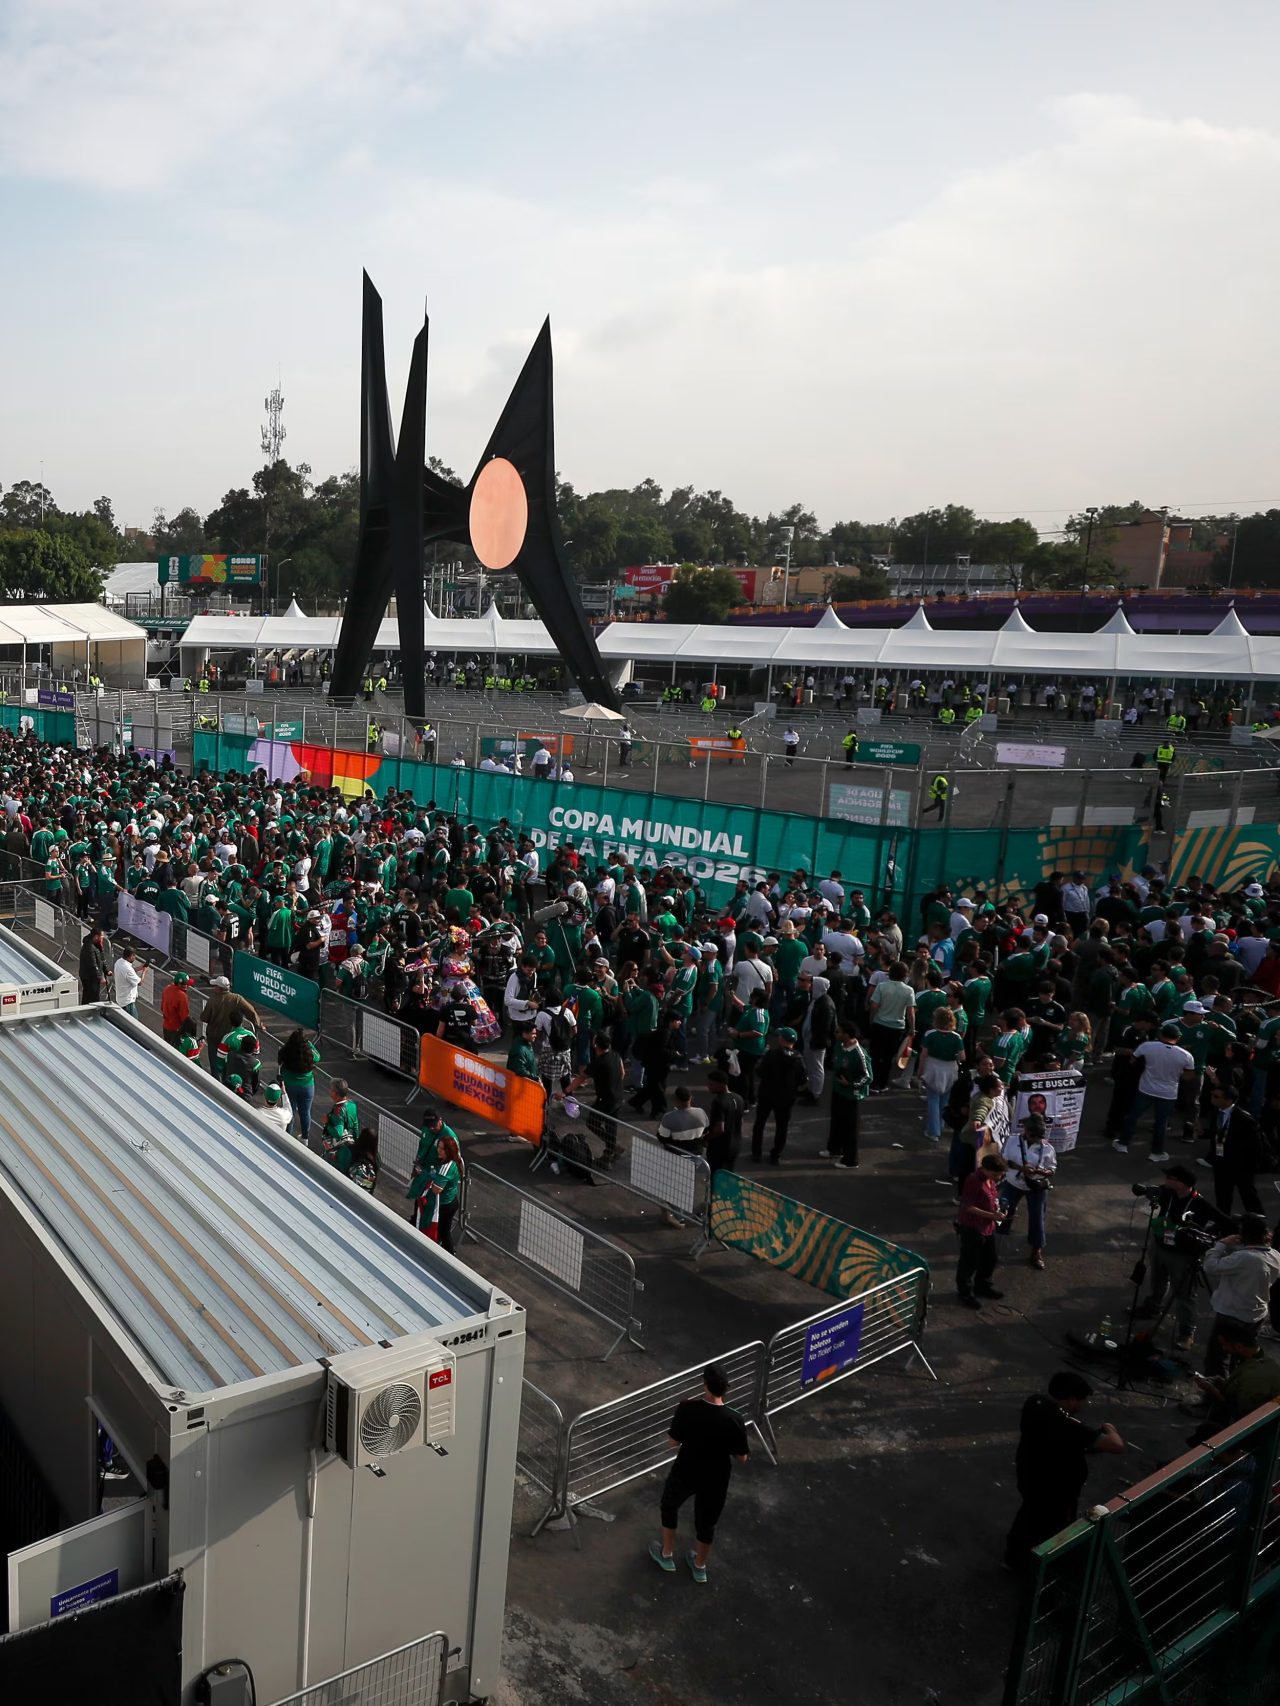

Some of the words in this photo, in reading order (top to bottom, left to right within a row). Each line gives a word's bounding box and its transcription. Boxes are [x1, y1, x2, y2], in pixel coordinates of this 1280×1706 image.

[548, 806, 616, 836] COPA
[620, 817, 749, 858] MUNDIAL
[530, 827, 562, 851] DE
[663, 851, 767, 886] 2026
[231, 921, 240, 939] 16
[265, 967, 283, 981] FIFA
[253, 971, 280, 990] WORLD
[280, 984, 297, 998] CUP
[260, 985, 288, 1005] 2026
[453, 1070, 491, 1094] CIUDAD
[492, 1087, 506, 1100] DE
[1031, 1081, 1044, 1090] SE
[1045, 1079, 1076, 1088] BUSCA
[453, 1080, 506, 1113] MÉXICO
[811, 1333, 820, 1341] No
[820, 1329, 828, 1338] se
[828, 1320, 849, 1335] venden
[808, 1353, 817, 1362] No
[817, 1345, 833, 1358] Ticket
[809, 1337, 832, 1352] boletos
[432, 1374, 449, 1384] TCL
